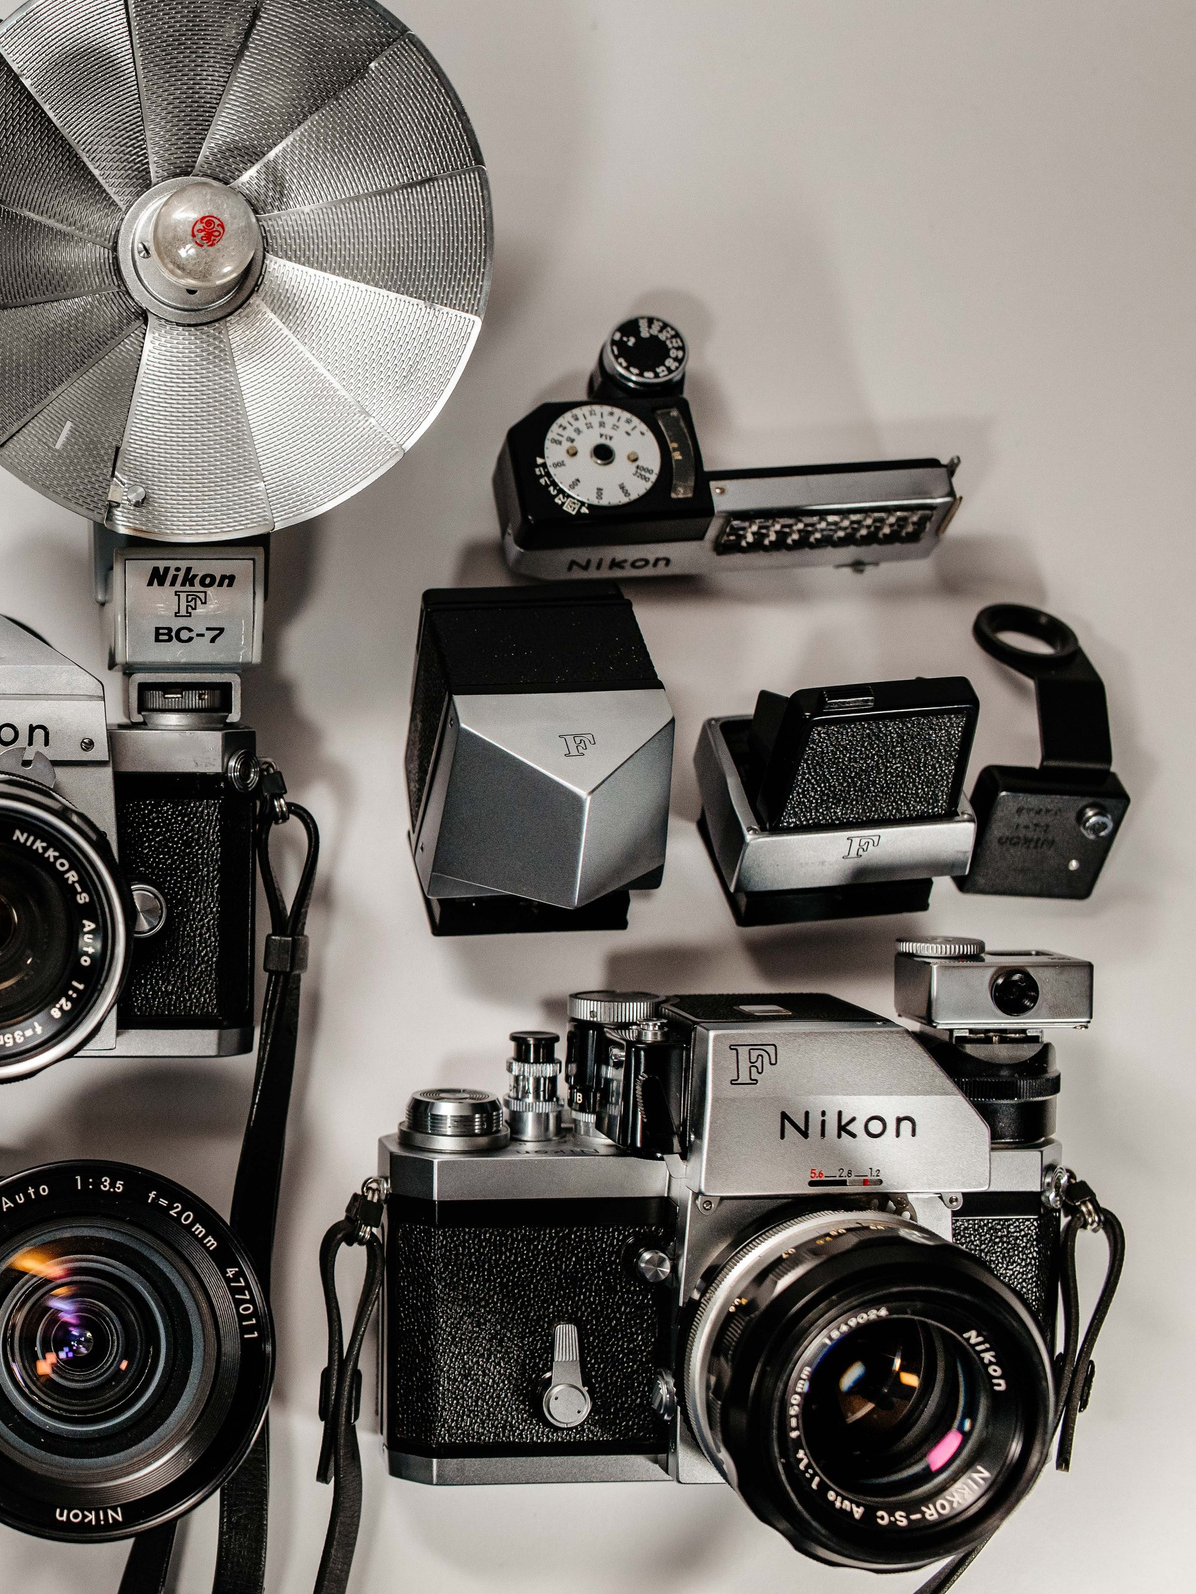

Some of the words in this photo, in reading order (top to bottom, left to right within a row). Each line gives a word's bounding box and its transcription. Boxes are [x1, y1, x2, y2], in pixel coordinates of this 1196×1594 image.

[146, 566, 237, 588] Nikon
[566, 553, 672, 574] Nikon
[174, 590, 208, 618] F
[154, 626, 226, 644] BC-7
[558, 732, 597, 757] F
[842, 834, 882, 860] F
[12, 829, 90, 905] NIKKOR-S
[80, 919, 96, 967] Auto
[51, 980, 85, 1020] 1:2.8
[729, 1043, 778, 1086] F
[576, 1092, 583, 1103] B
[778, 1109, 918, 1141] Nikon
[809, 1168, 825, 1179] 5.6
[837, 1167, 853, 1178] 2.8
[868, 1166, 881, 1177] 1.2
[1, 1183, 50, 1212] Auto
[74, 1175, 125, 1193] 1:3.5
[147, 1190, 218, 1251] f=20mm
[225, 1266, 259, 1339] 477011
[961, 1329, 1007, 1392] Nikon
[55, 1506, 123, 1526] Nikon
[827, 1489, 866, 1520] Auto
